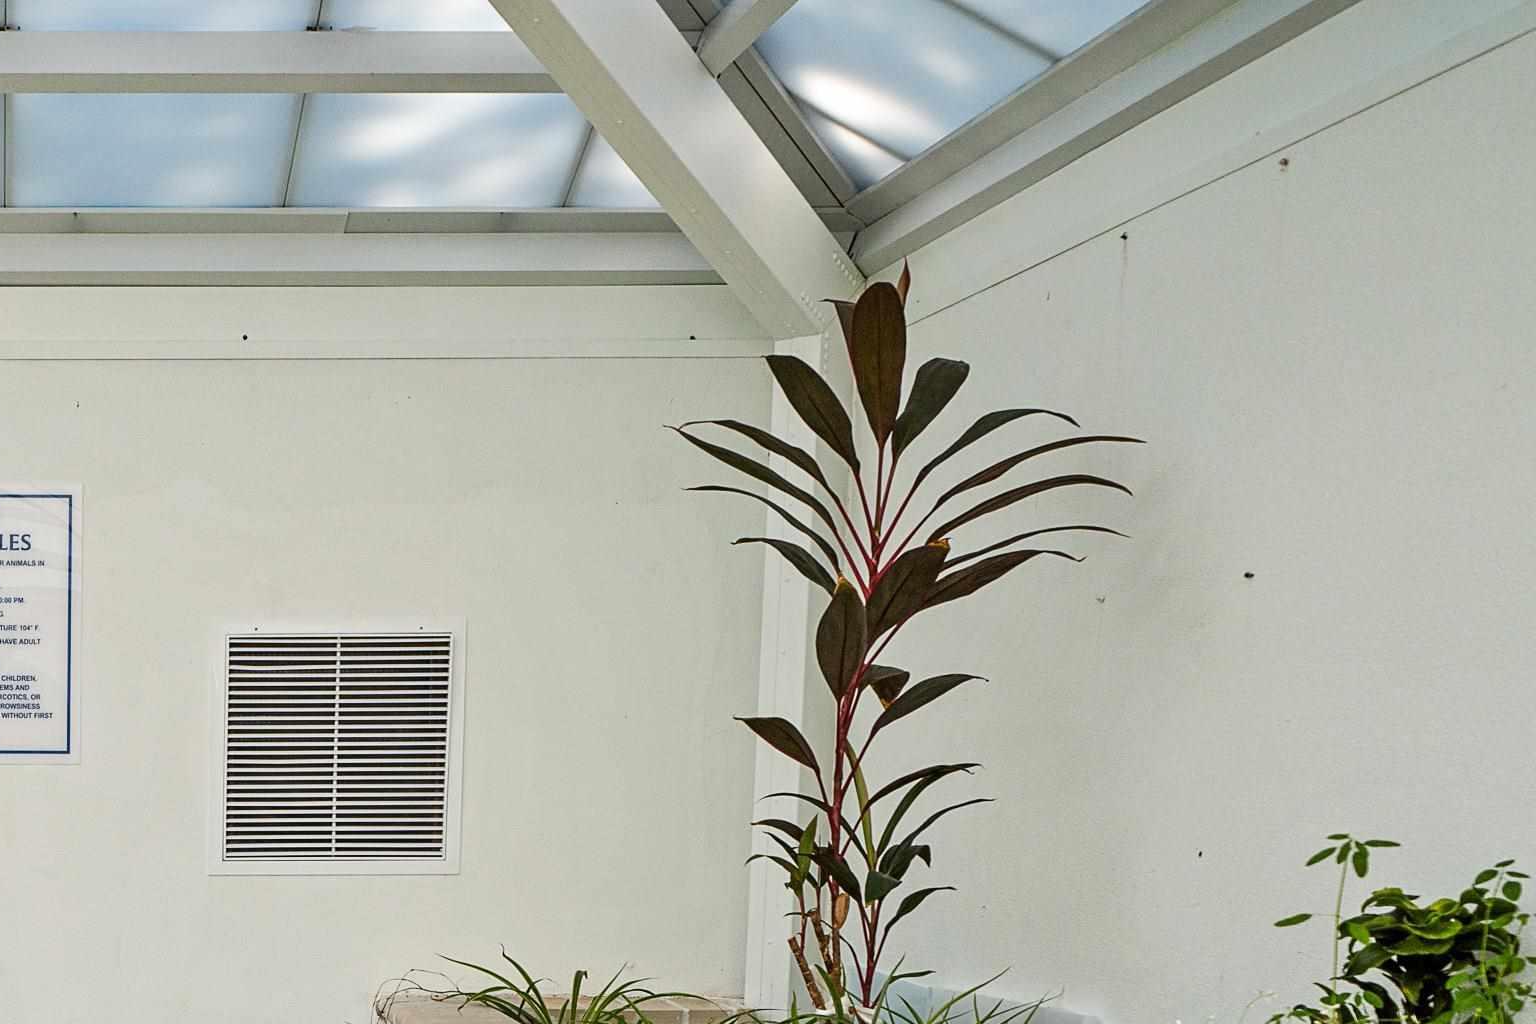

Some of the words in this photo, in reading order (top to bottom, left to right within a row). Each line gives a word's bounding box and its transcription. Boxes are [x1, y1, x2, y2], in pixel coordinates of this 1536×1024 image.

[6, 559, 36, 567] ANIMALS
[0, 638, 18, 646] HAVE
[19, 638, 41, 646] ADULT
[15, 684, 30, 692] AND
